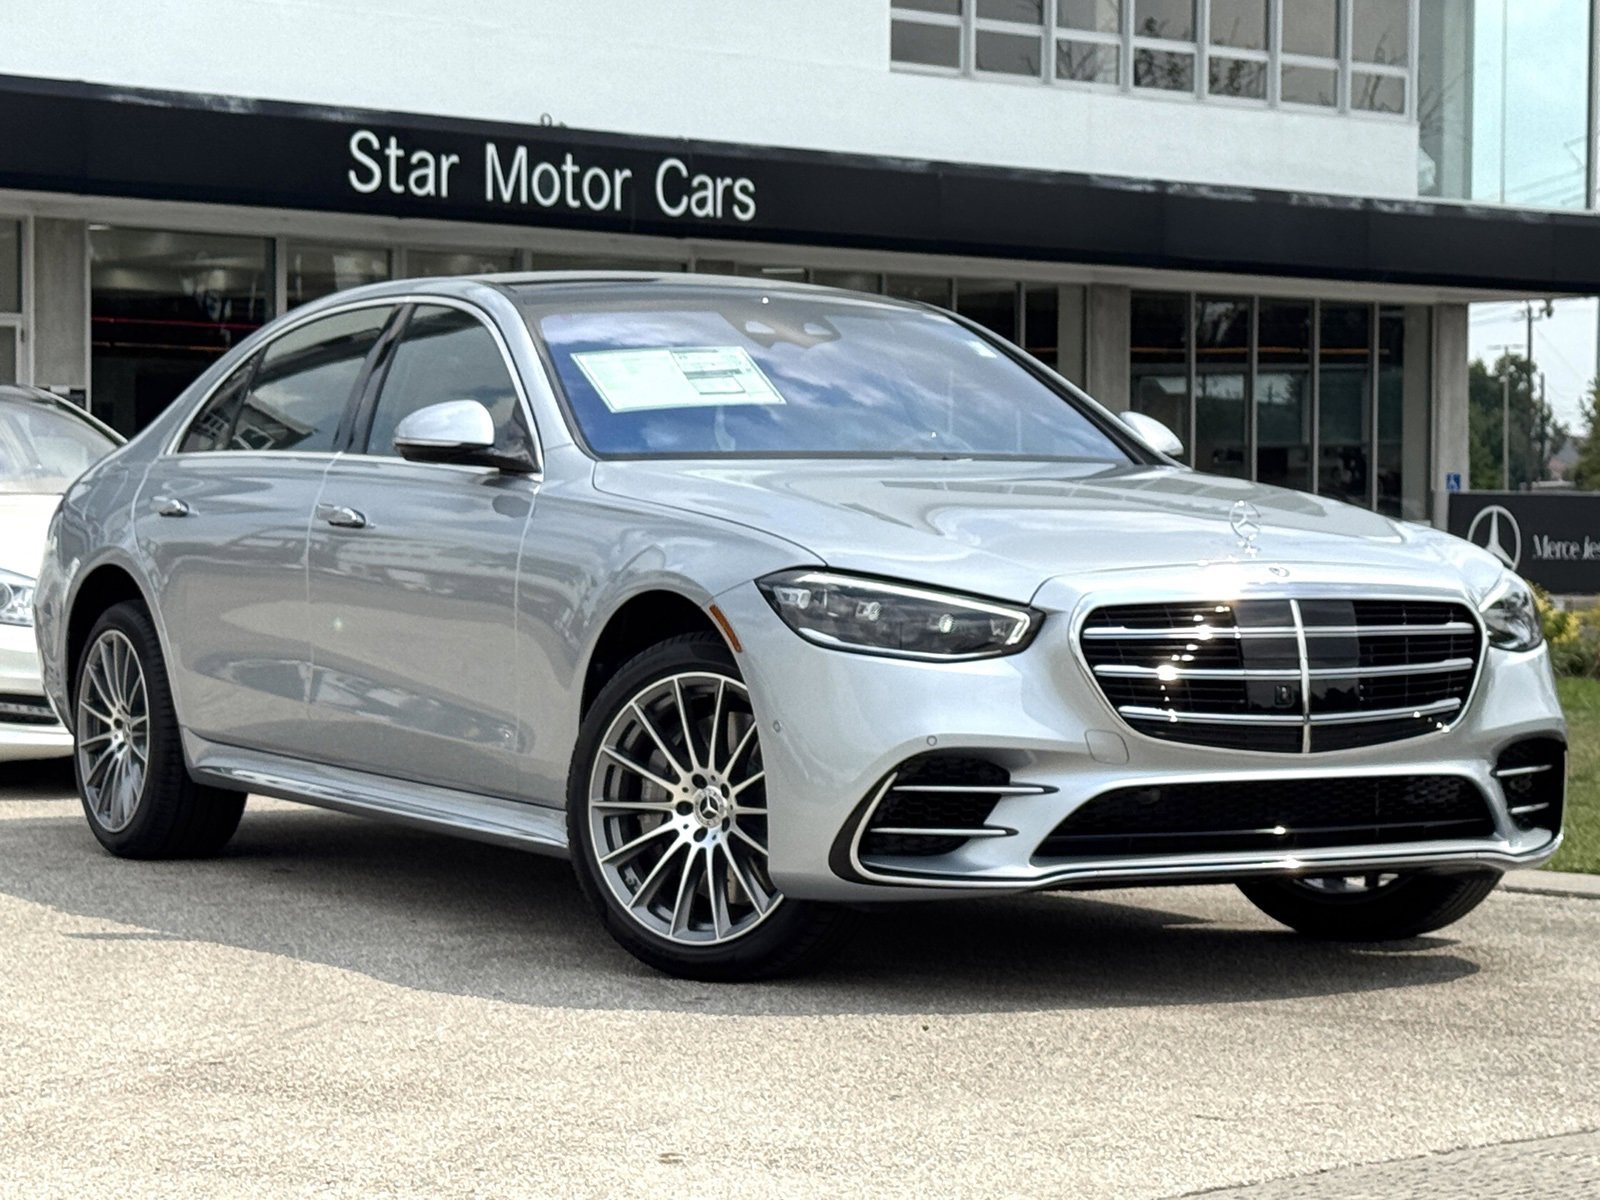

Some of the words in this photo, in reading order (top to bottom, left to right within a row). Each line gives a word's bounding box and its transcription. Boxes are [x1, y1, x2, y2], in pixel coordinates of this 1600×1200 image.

[348, 130, 460, 197] Star
[485, 142, 632, 211] Motor
[655, 158, 756, 221] Cars
[1532, 534, 1600, 560] Mercede
